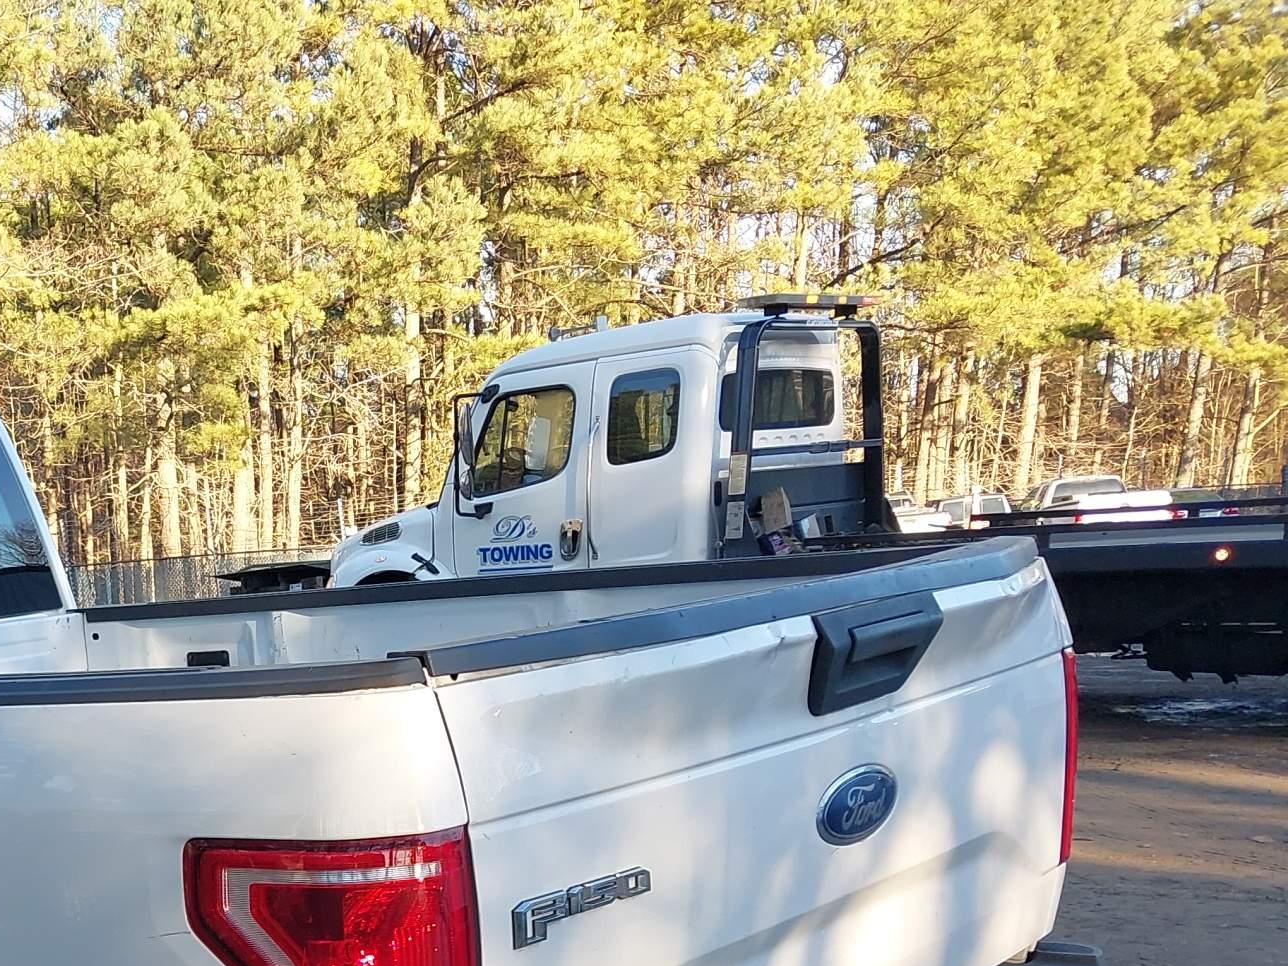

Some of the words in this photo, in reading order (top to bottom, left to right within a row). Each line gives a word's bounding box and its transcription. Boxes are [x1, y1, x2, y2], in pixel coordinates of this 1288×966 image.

[490, 514, 538, 542] D's
[478, 544, 553, 565] TOWING
[842, 783, 886, 831] Ford
